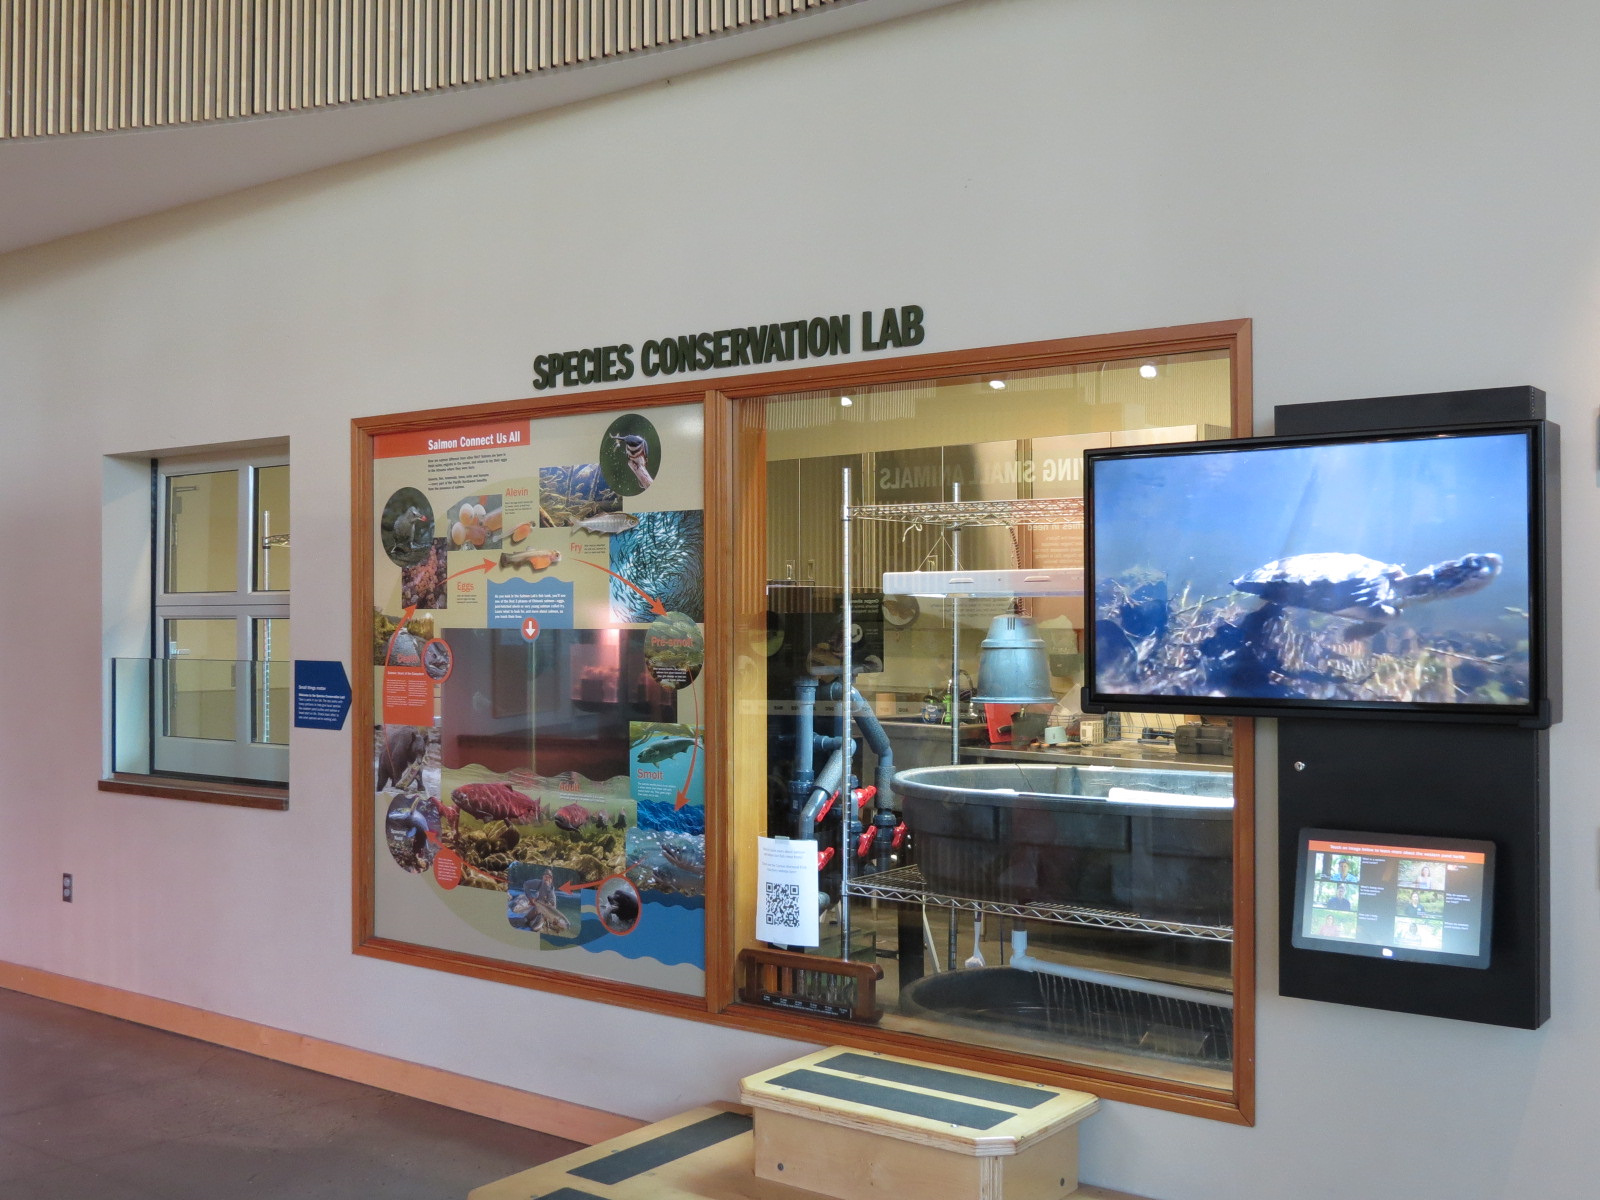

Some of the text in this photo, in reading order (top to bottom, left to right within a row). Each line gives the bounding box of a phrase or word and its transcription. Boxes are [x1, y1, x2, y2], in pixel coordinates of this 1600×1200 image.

[533, 304, 924, 390] SPECIES CONSERVATION LAB
[428, 431, 520, 450] Salmon Connect Us All
[506, 488, 528, 496] Alevin
[570, 542, 582, 554] Fry
[457, 582, 474, 592] Eggs
[637, 768, 663, 780] Smolt
